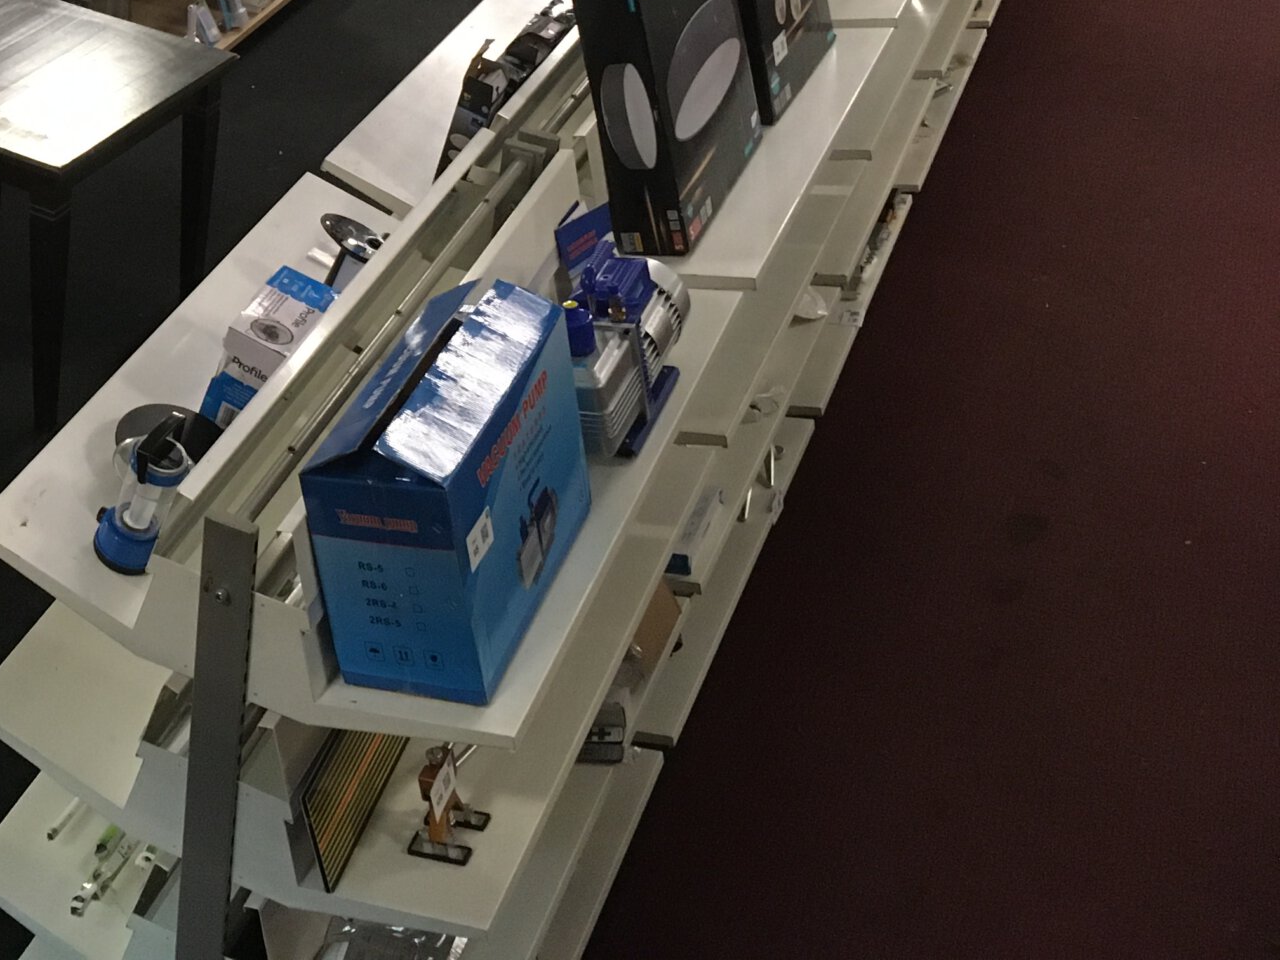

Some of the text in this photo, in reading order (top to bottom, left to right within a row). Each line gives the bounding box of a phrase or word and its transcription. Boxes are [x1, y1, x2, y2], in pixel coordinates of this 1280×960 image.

[292, 306, 316, 329] Profile
[231, 355, 269, 383] Profile
[476, 410, 521, 488] VACUUM
[521, 369, 548, 419] PUMP
